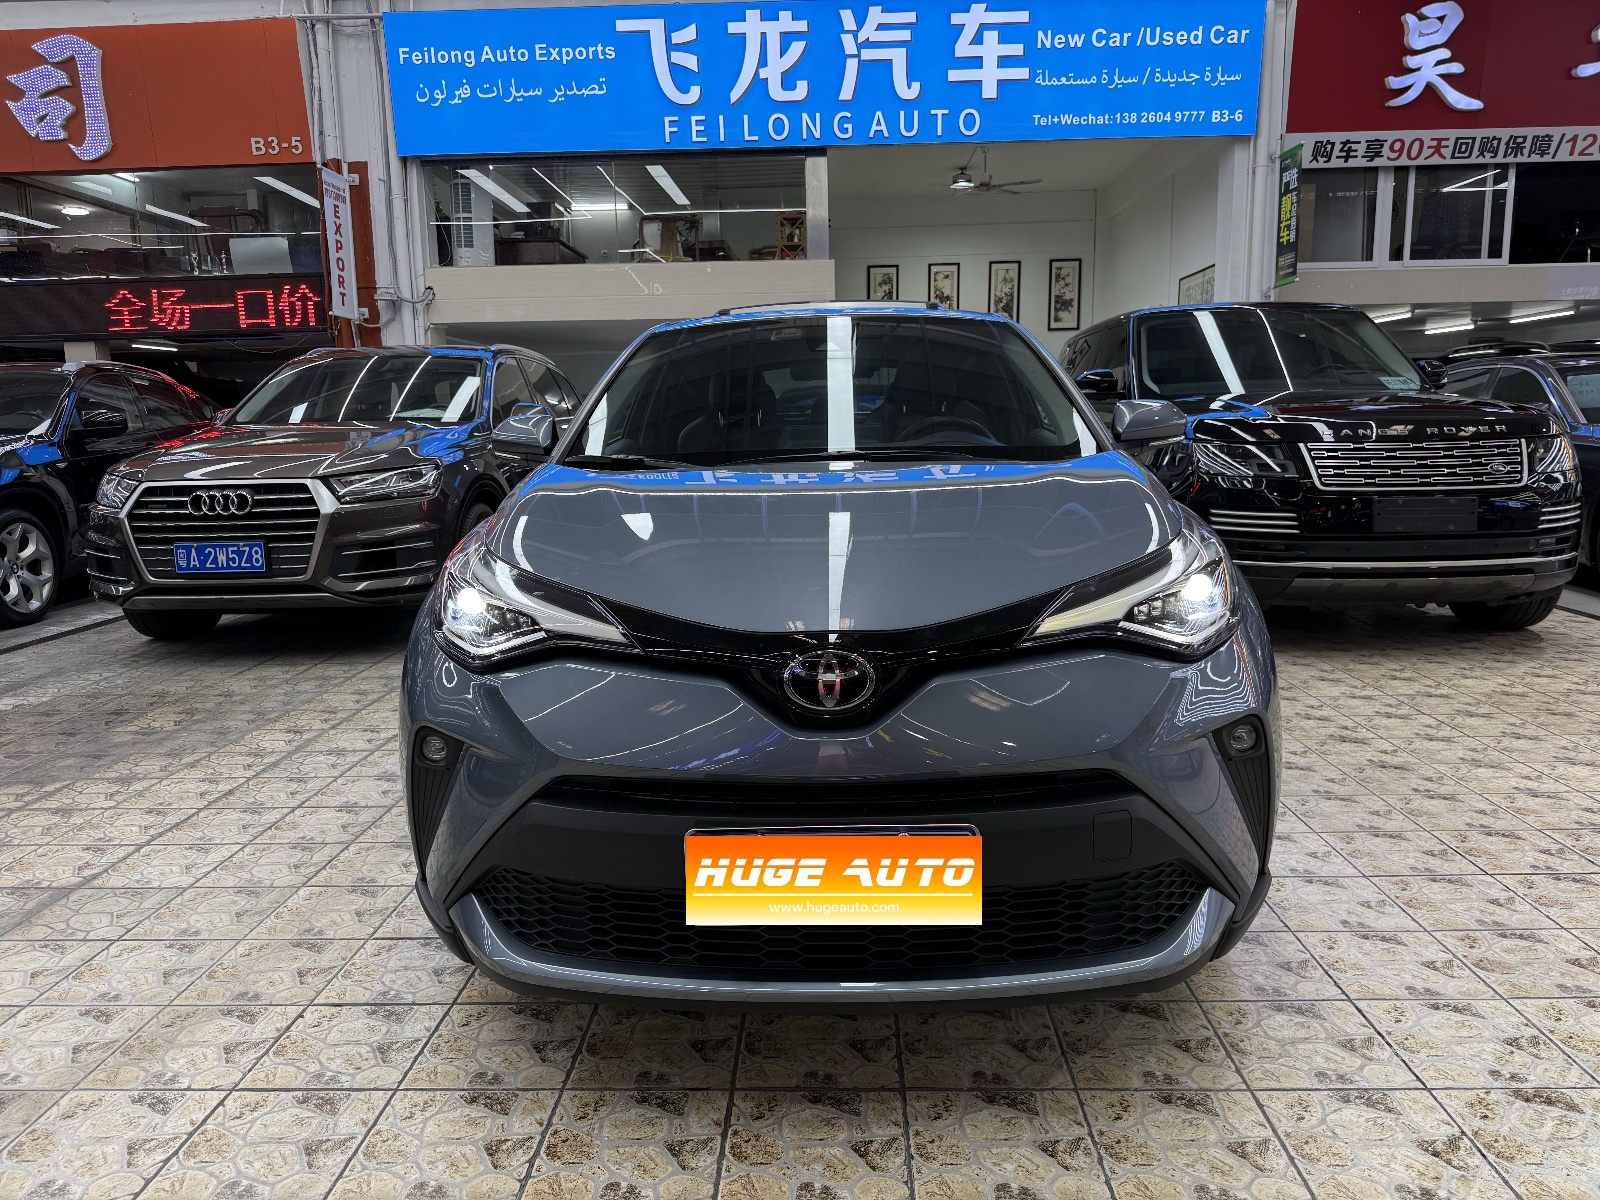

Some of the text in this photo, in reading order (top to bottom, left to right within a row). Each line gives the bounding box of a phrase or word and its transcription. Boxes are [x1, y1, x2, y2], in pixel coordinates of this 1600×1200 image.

[1036, 29, 1085, 49] New
[1091, 28, 1132, 47] Car
[1209, 25, 1250, 45] Car
[398, 43, 616, 68] Feilong Auto Exports
[615, 3, 1030, 106] 飞龙汽车
[1034, 69, 1097, 86] مستعملة
[1101, 68, 1139, 89] سيارة
[1154, 67, 1200, 87] جديدة
[1204, 65, 1242, 86] سيارة
[5, 34, 113, 161] 司
[476, 78, 543, 103] سيارات
[548, 77, 607, 103] تصدير
[1140, 112, 1172, 124] 2604
[1174, 110, 1206, 123] 9777
[1211, 109, 1243, 123] B3-6
[250, 136, 303, 156] B3-5
[1309, 133, 1600, 164] 购车享90天回购保障/12
[332, 203, 347, 307] EXPORT
[105, 284, 321, 331] 全场一口价
[1426, 425, 1507, 436] ROVER
